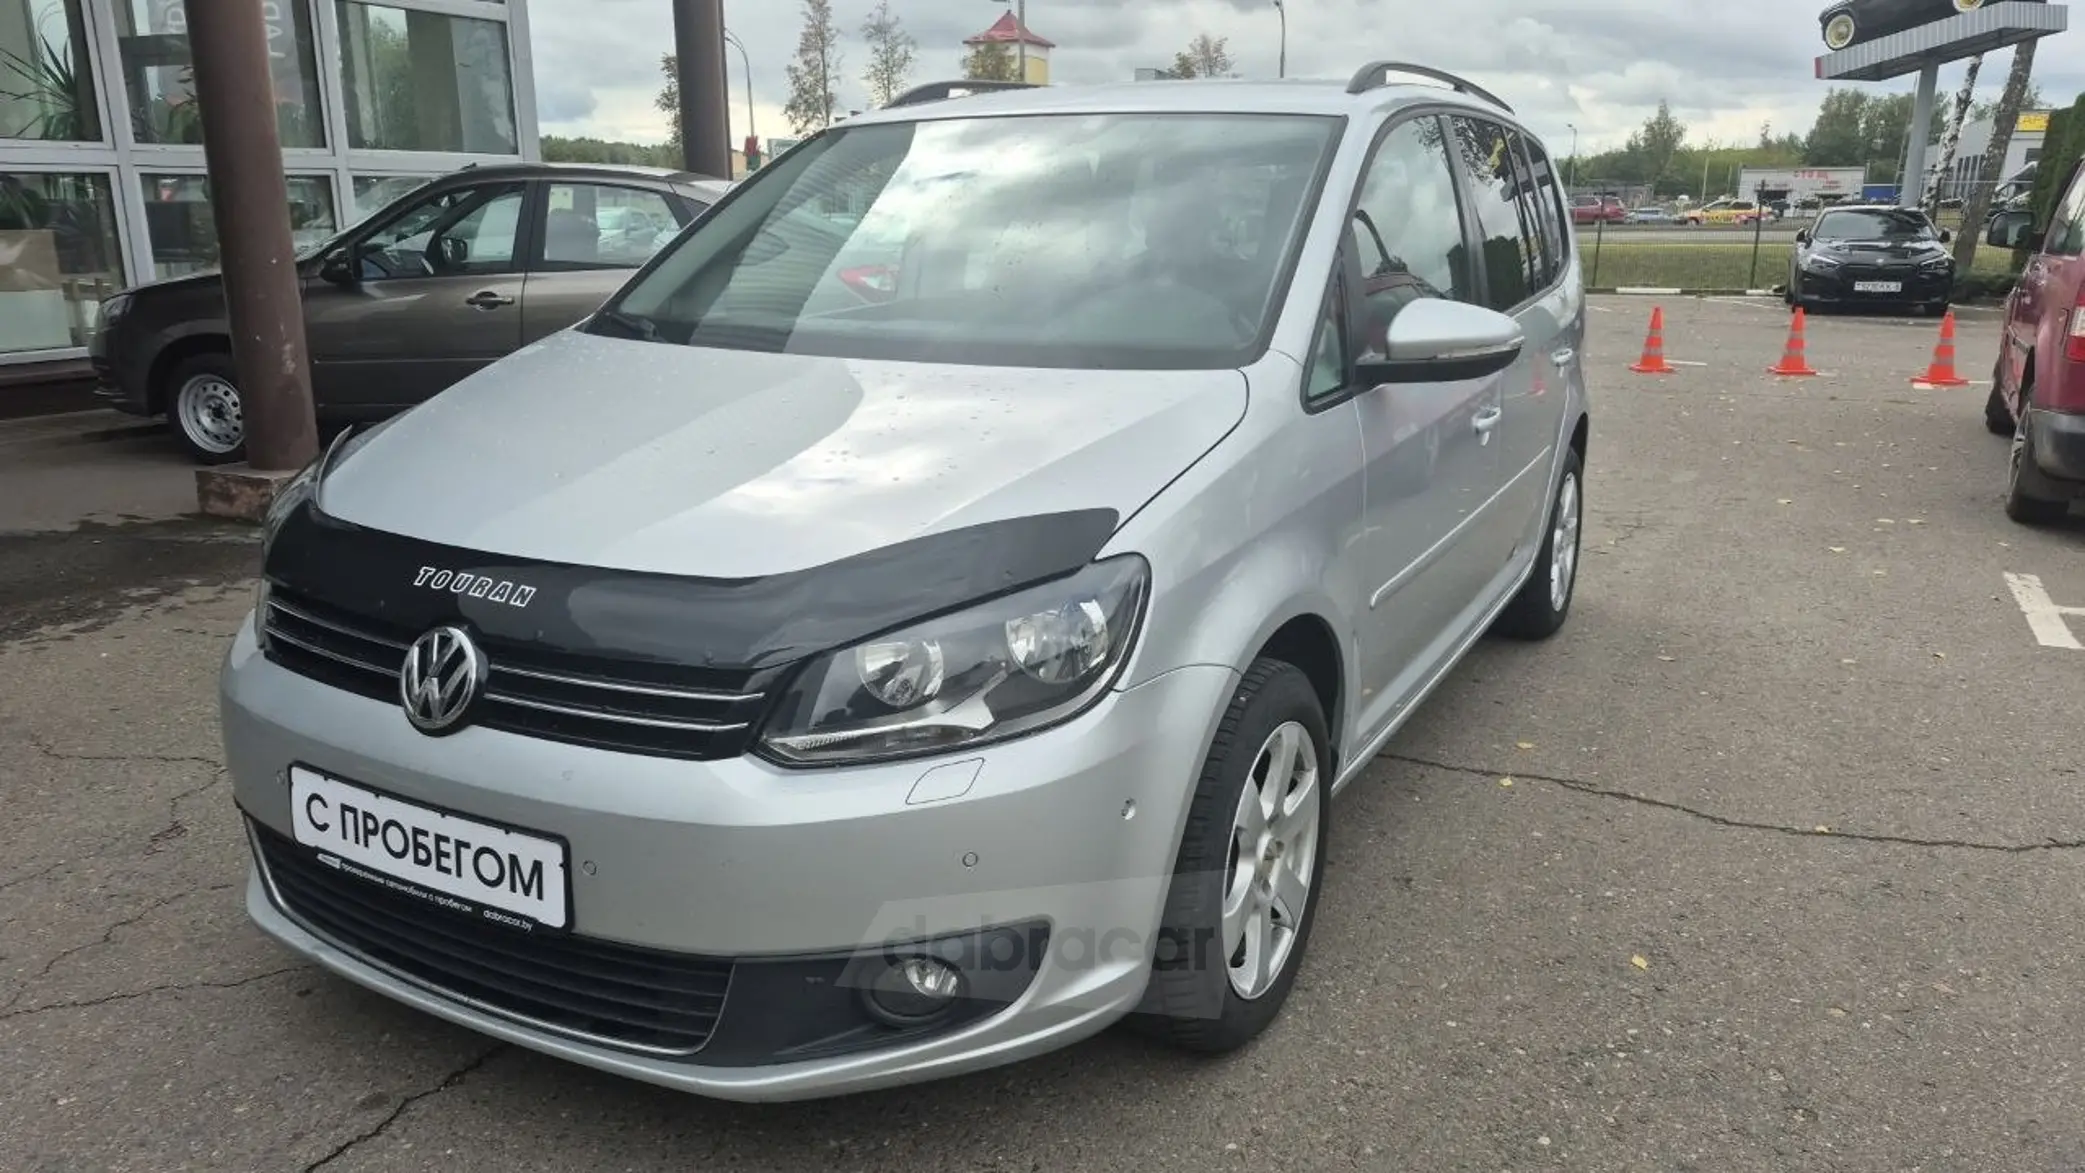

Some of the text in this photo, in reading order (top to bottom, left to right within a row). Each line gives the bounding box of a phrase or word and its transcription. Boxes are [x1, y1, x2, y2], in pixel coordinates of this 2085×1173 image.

[413, 566, 537, 607] TOURAN
[306, 793, 544, 901] С ПРОБЕГОМ
[434, 894, 473, 913] пробегом
